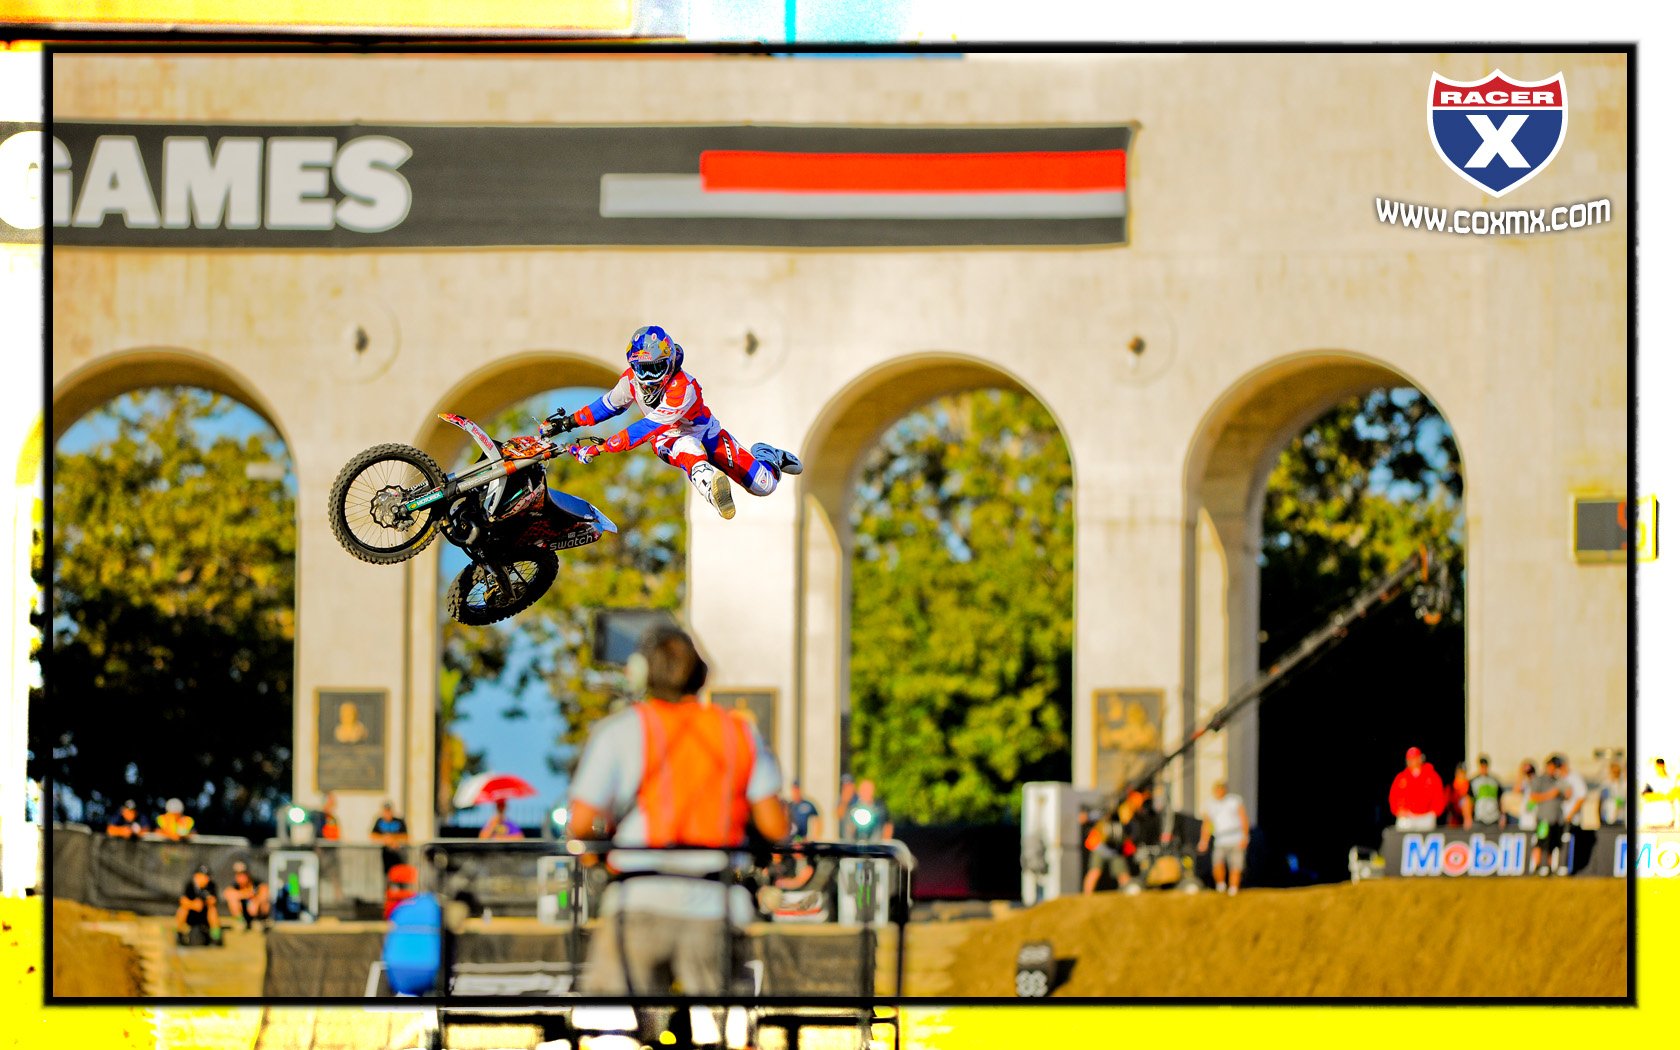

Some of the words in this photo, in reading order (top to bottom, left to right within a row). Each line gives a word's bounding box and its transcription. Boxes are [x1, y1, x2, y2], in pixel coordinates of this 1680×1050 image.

[0, 131, 413, 233] GAMES
[549, 534, 593, 551] swatch
[1401, 833, 1527, 877] Mobil
